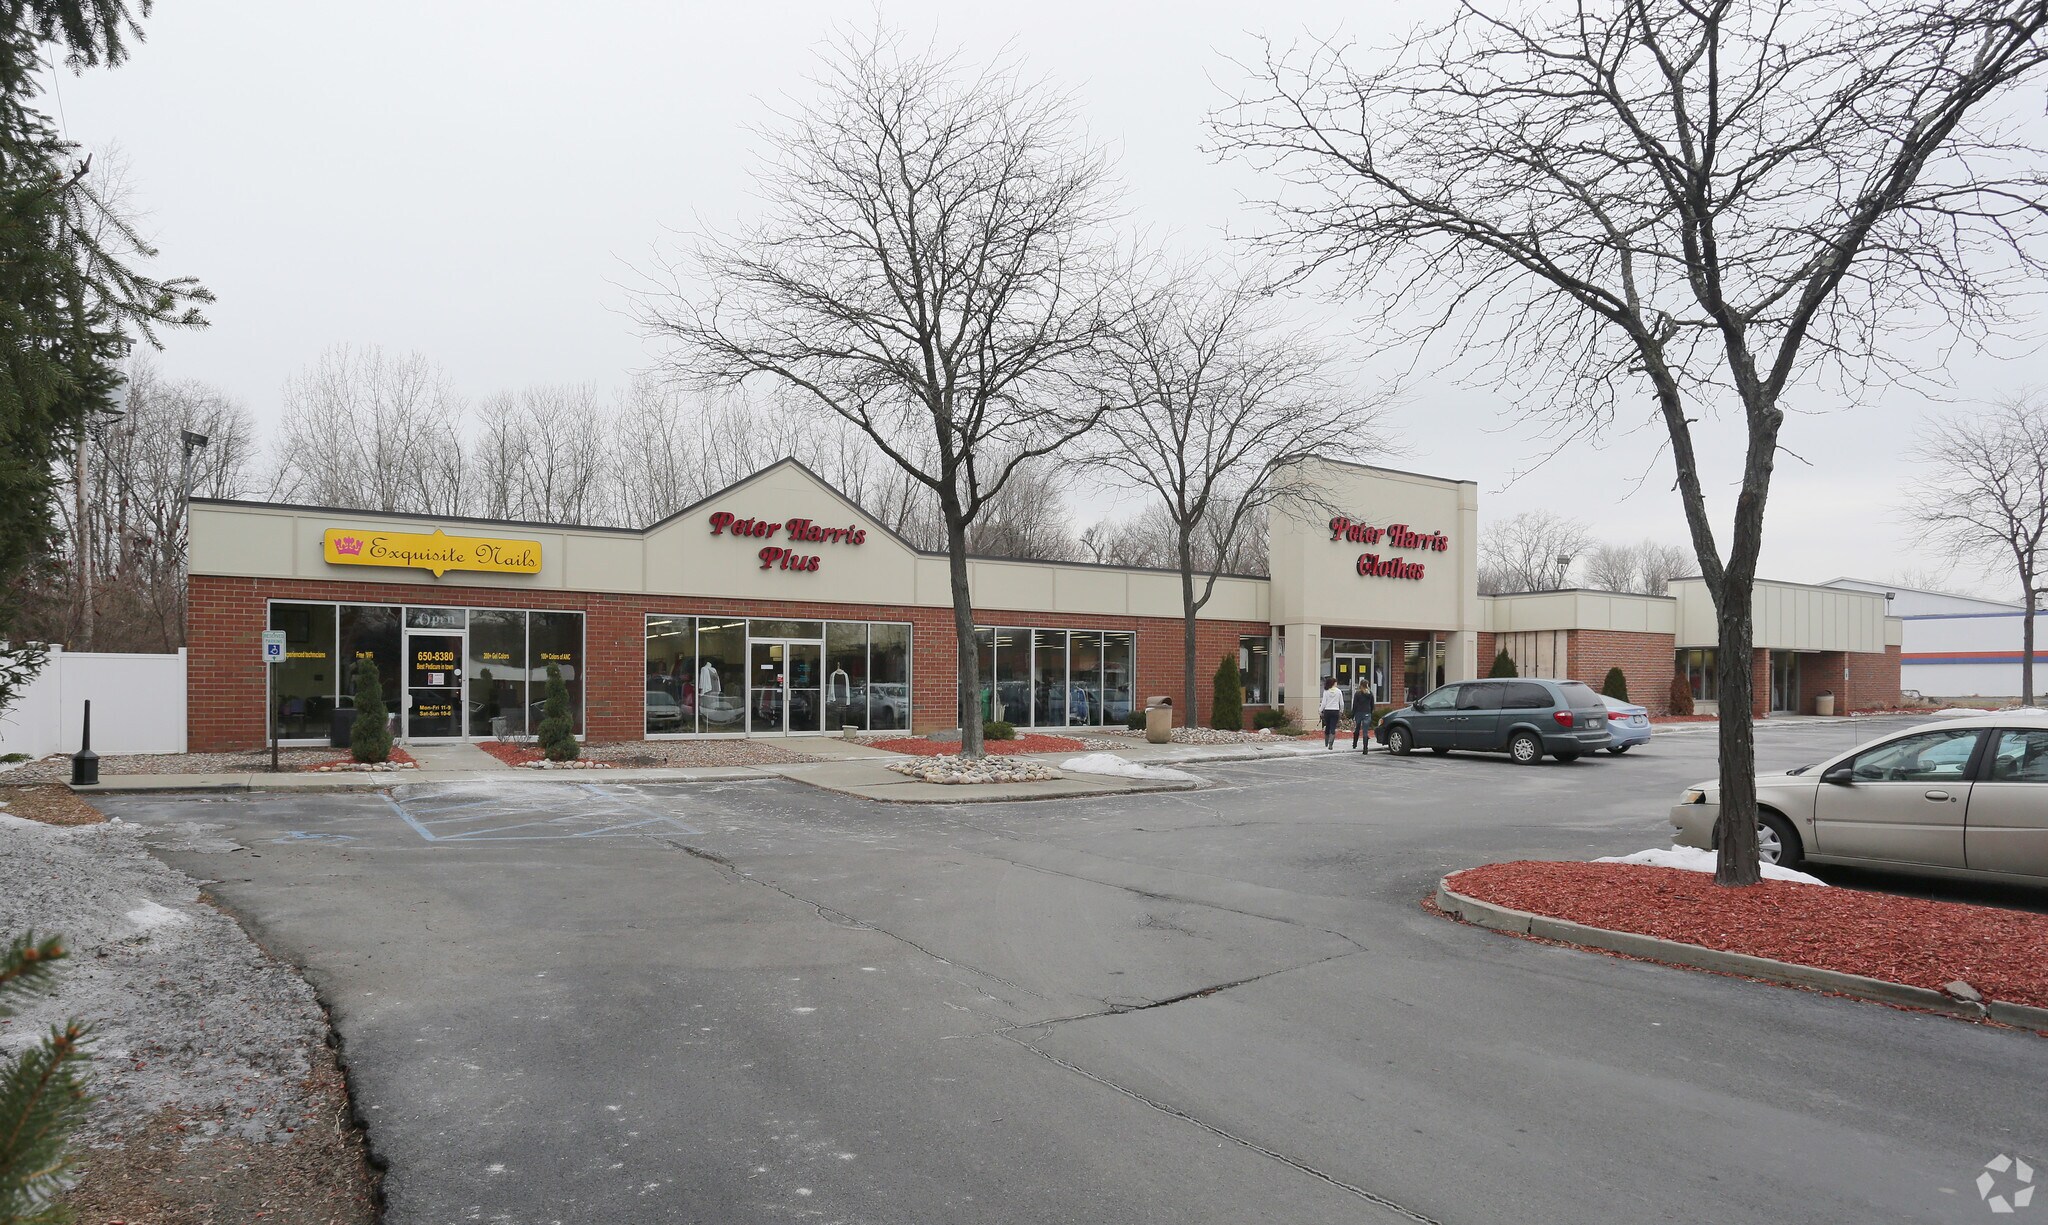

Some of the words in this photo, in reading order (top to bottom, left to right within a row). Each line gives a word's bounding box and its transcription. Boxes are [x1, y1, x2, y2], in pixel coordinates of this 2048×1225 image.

[709, 511, 782, 539] Peter
[785, 518, 867, 545] Harris
[1329, 516, 1386, 545] Peter
[1387, 524, 1449, 552] Harris
[369, 537, 466, 565] Exquisite
[475, 544, 538, 567] Nails
[758, 546, 821, 571] Plus
[1356, 553, 1426, 580] Clothes
[415, 612, 456, 627] Open
[417, 651, 454, 661] 650-8380
